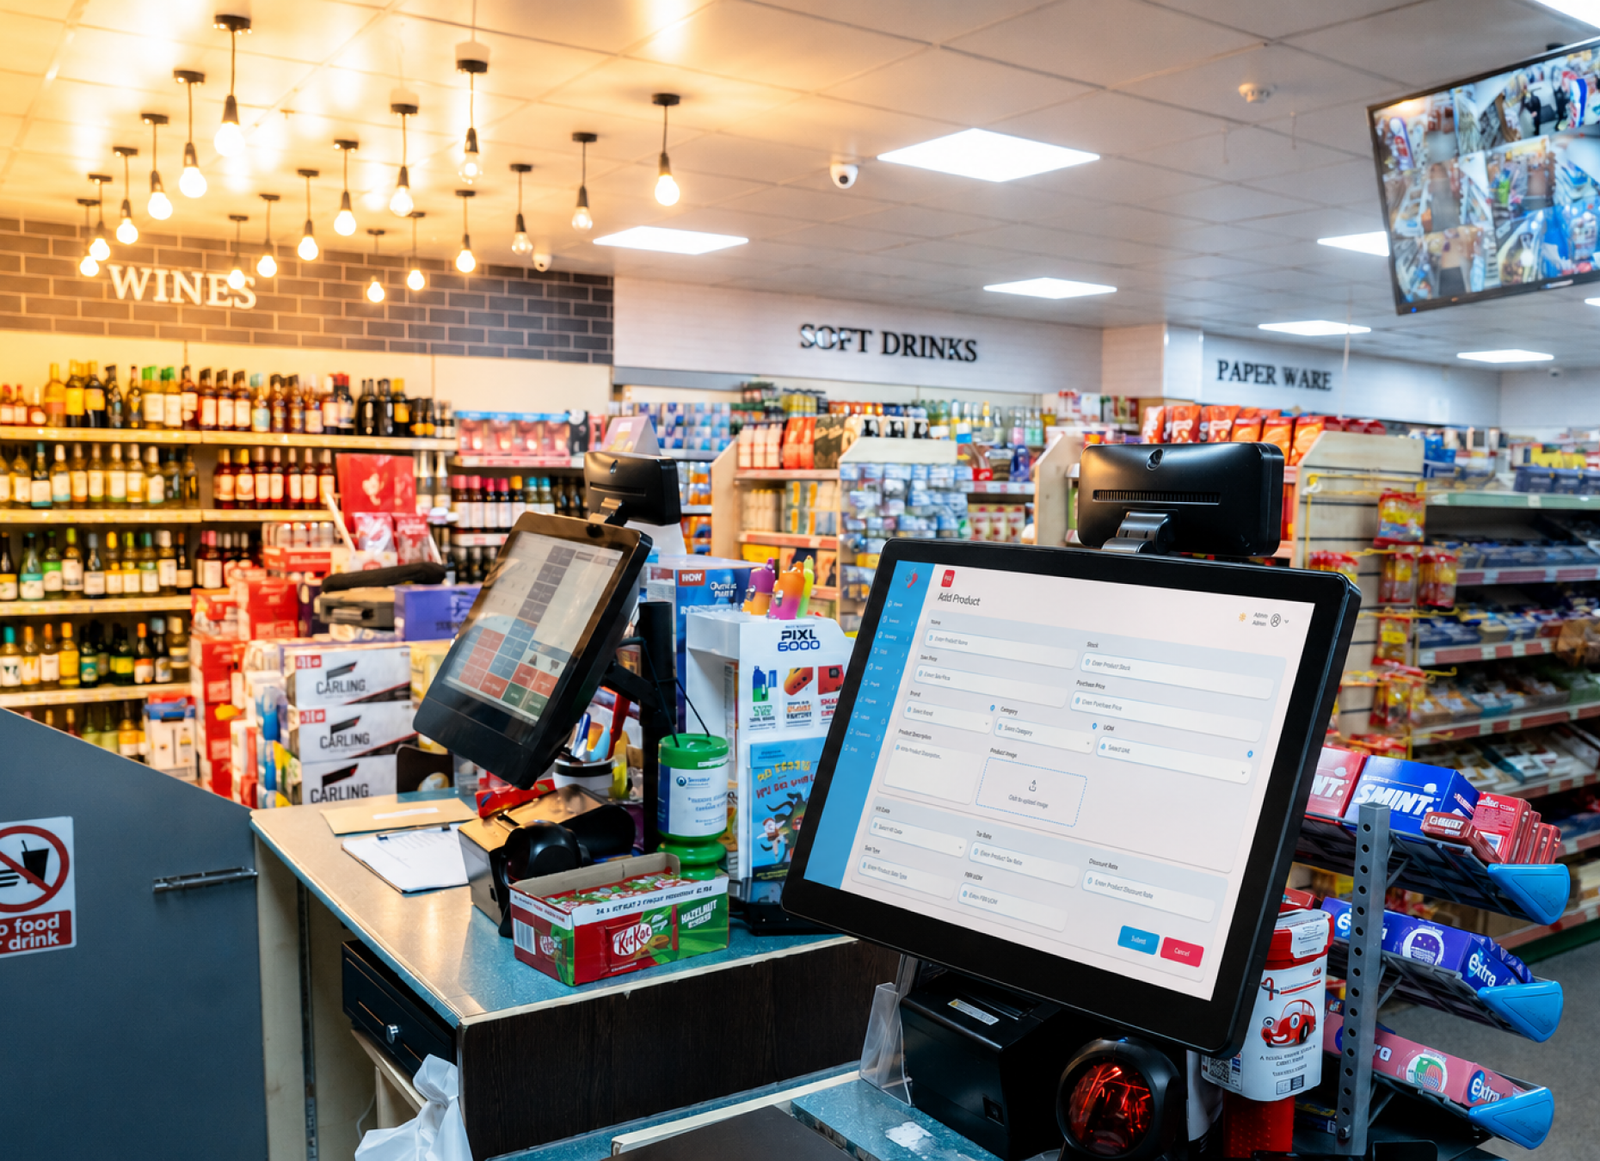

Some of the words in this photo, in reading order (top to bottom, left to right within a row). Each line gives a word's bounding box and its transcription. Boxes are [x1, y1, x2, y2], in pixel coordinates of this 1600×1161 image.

[108, 264, 256, 309] WINES
[801, 323, 873, 353] SOFT
[881, 331, 977, 362] DRINKS
[1217, 359, 1277, 385] PAPER
[1282, 366, 1333, 391] WARE
[938, 592, 952, 603] Add
[953, 593, 981, 606] Product
[781, 629, 817, 642] PIXL
[777, 640, 820, 652] 6000
[316, 679, 366, 696] CARLING
[320, 732, 370, 750] CARLING
[310, 783, 369, 804] CARLING
[14, 914, 60, 934] food
[8, 930, 60, 950] drink
[1174, 947, 1190, 957] Cancel
[1469, 952, 1497, 988] extra
